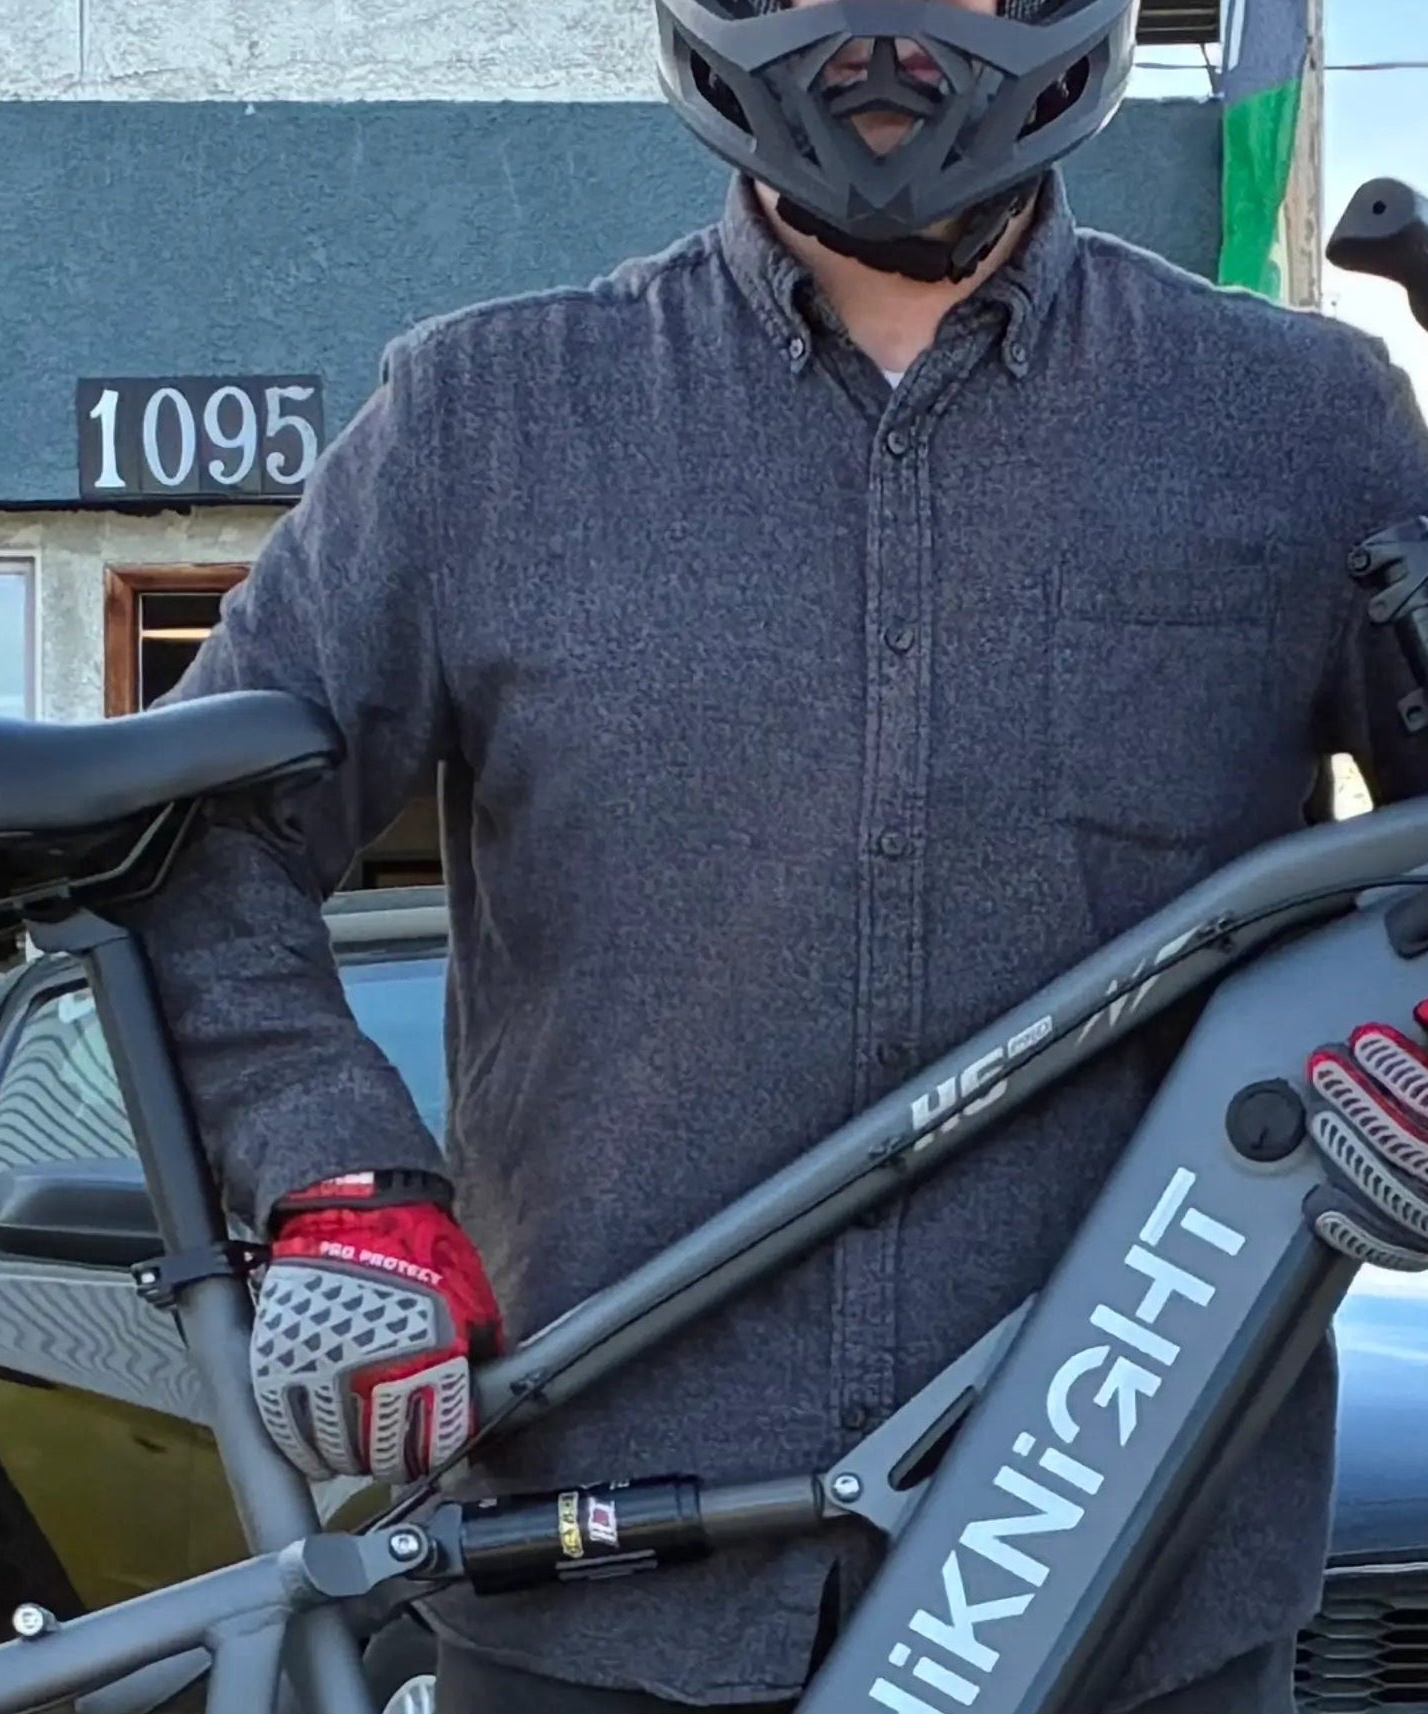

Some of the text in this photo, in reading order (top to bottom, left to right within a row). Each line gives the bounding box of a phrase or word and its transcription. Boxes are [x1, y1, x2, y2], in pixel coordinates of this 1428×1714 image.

[90, 386, 318, 487] 1095
[320, 1241, 443, 1285] PRO PROTECT
